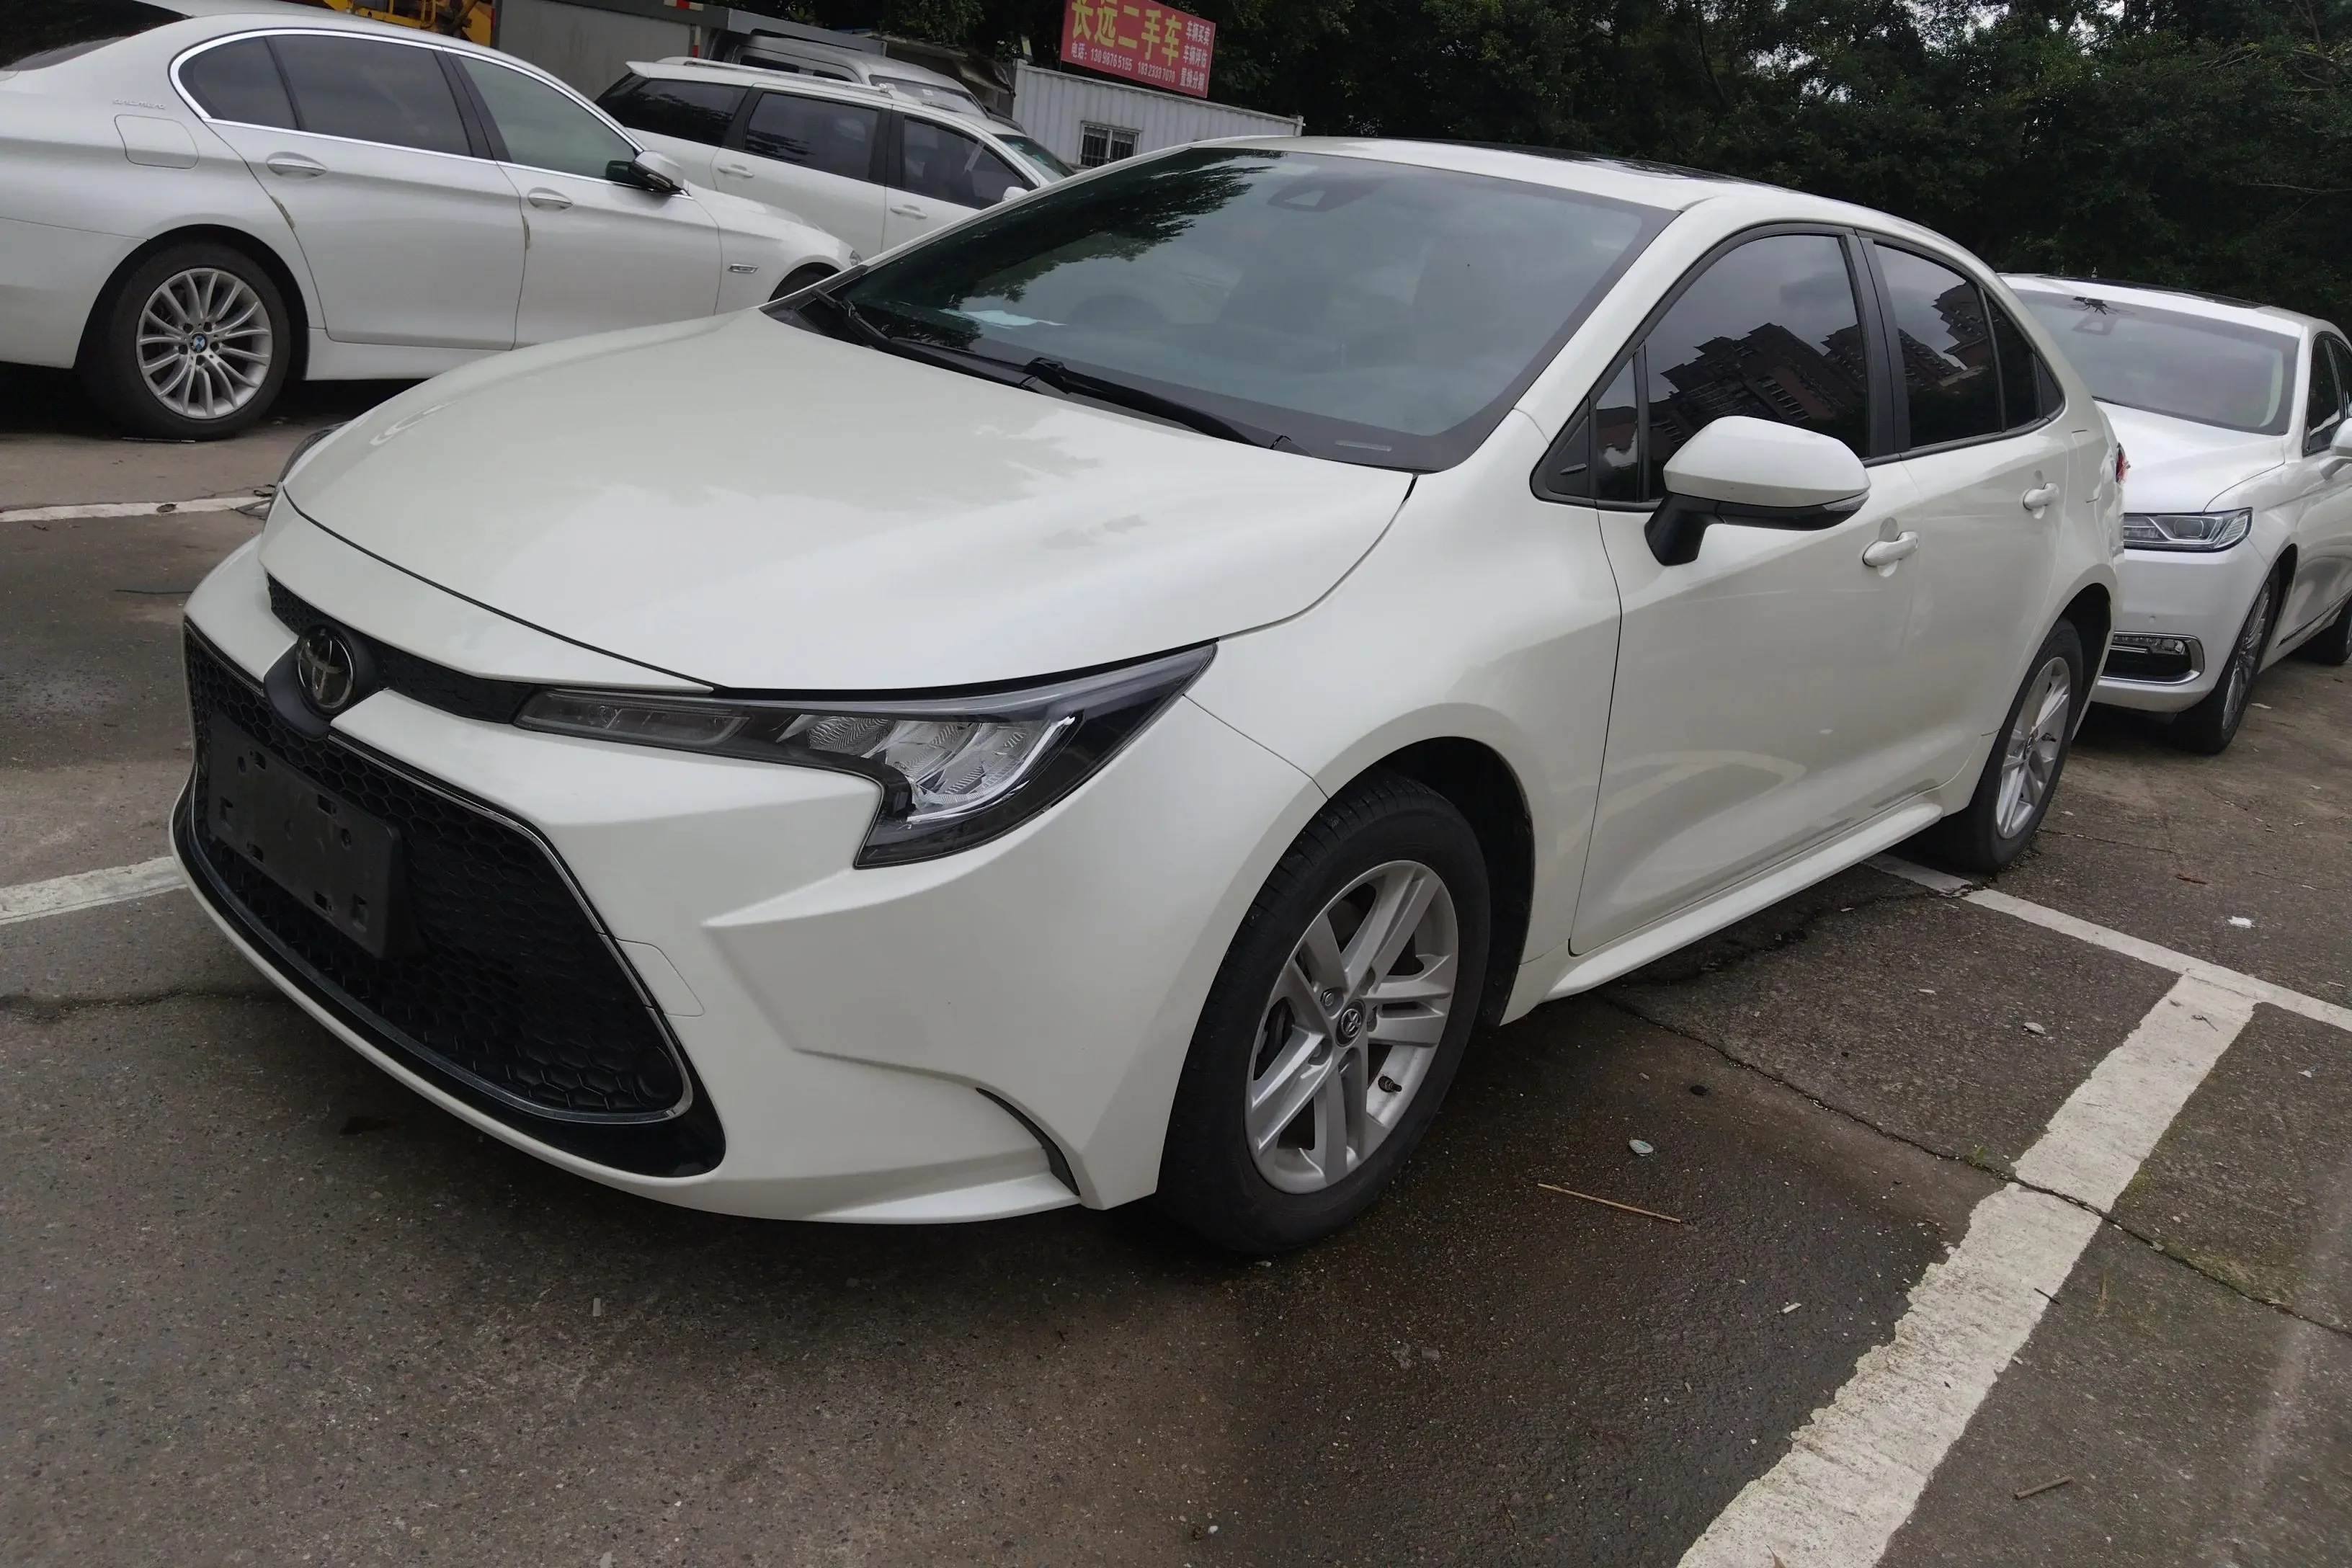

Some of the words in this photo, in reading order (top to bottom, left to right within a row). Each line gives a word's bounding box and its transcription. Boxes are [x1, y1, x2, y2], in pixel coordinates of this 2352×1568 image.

[1072, 0, 1182, 66] 长远二手车
